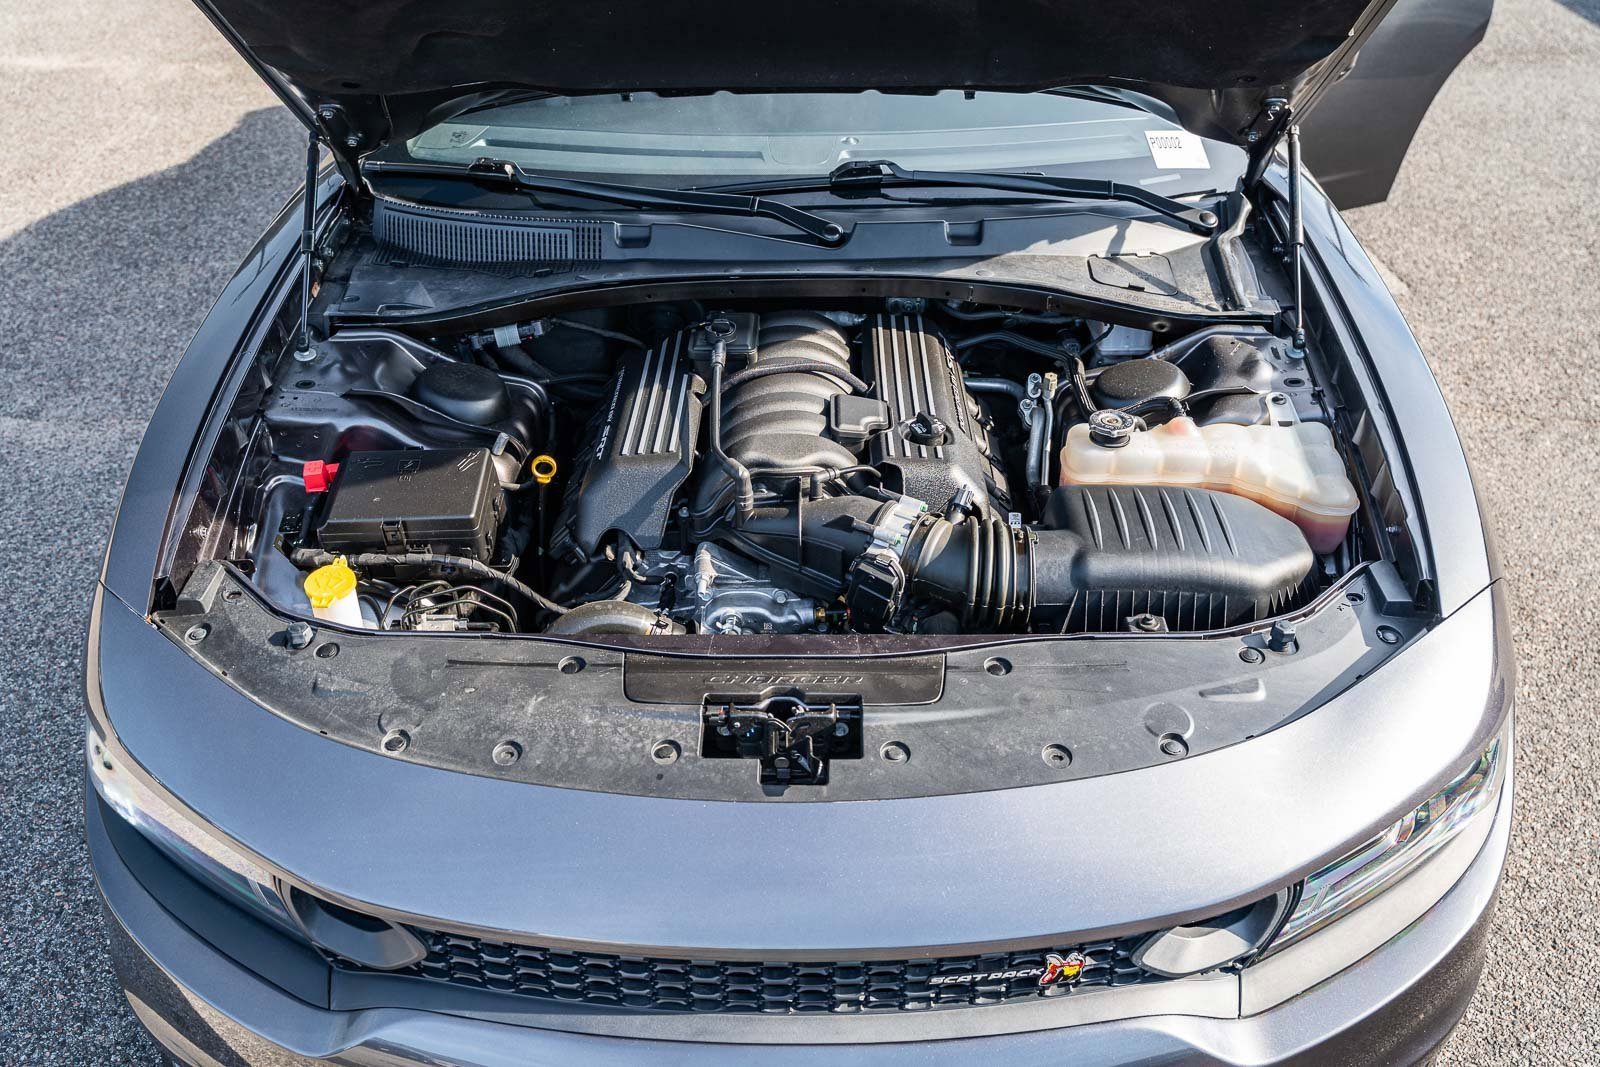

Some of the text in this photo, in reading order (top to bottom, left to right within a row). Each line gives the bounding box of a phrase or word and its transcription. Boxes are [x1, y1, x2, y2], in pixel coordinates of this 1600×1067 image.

[706, 674, 864, 685] CHARGER
[929, 968, 1044, 984] SCAT PACK
